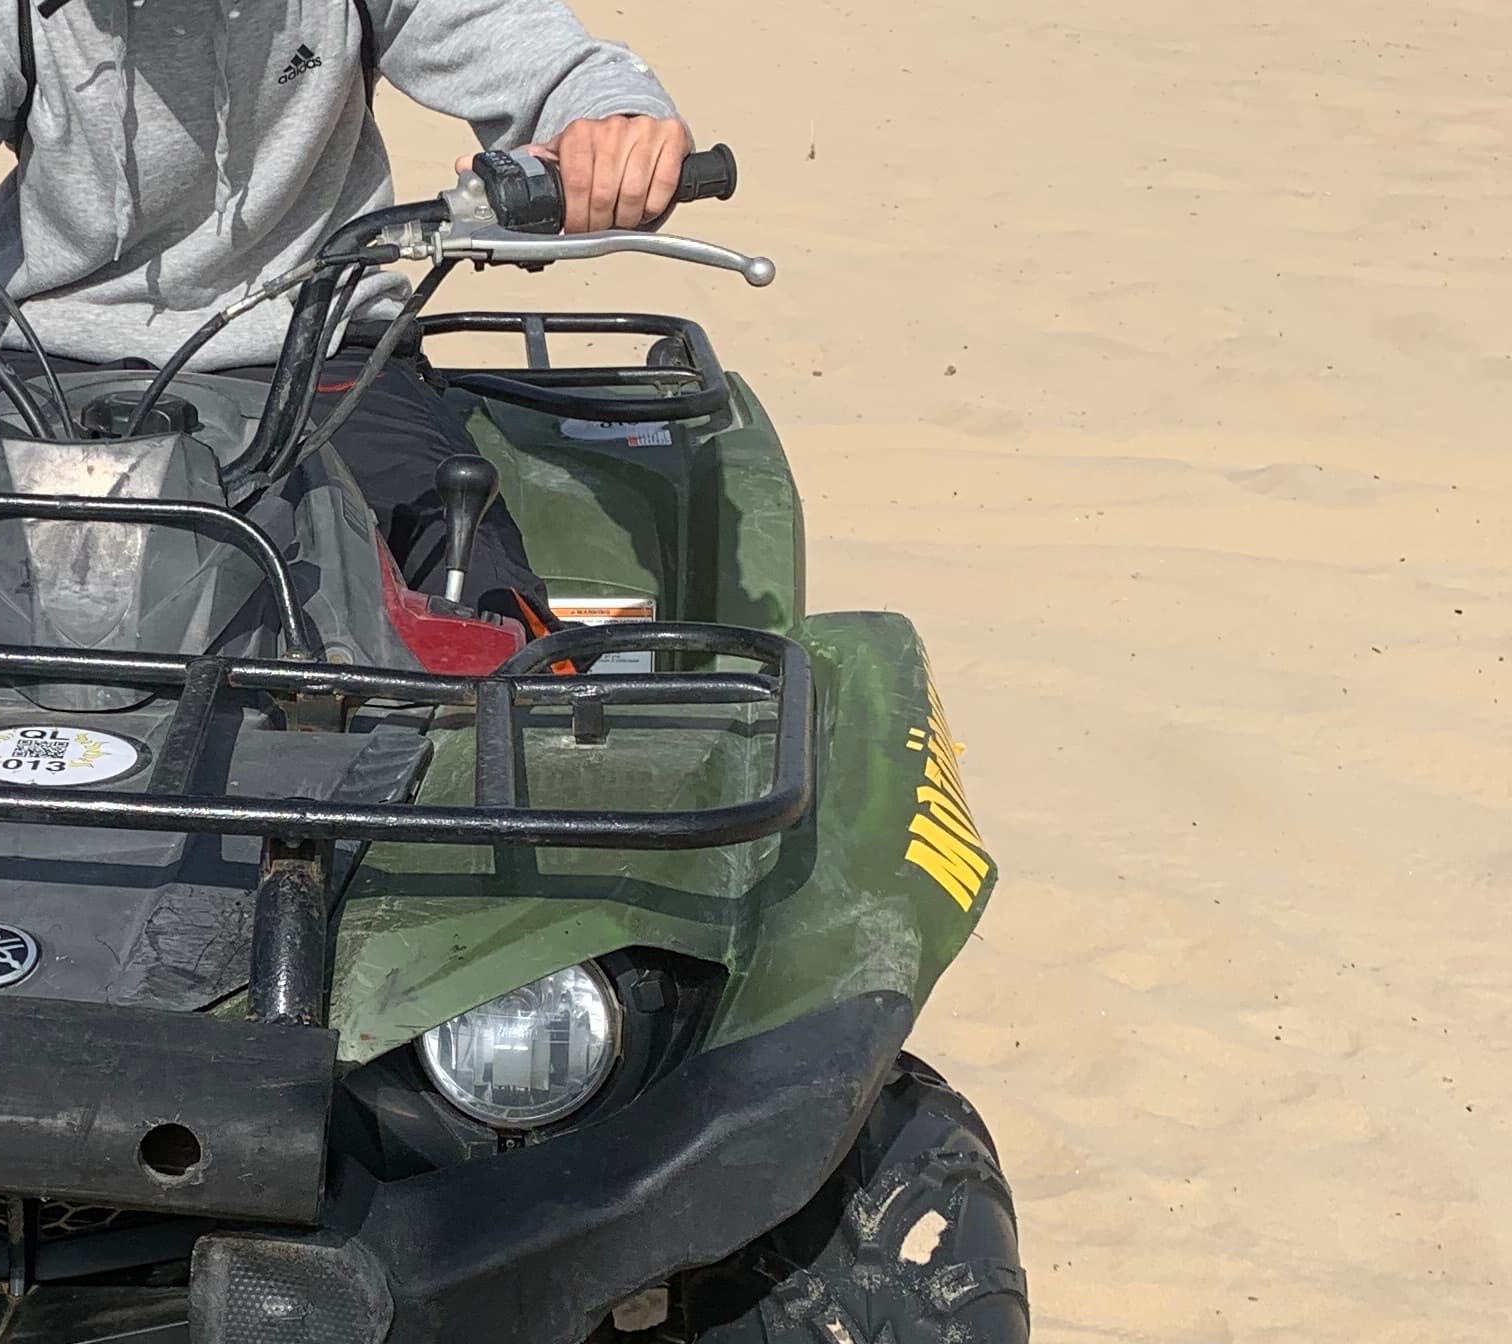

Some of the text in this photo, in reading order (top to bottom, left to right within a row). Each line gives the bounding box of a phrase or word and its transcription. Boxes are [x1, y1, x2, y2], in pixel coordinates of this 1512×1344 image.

[277, 56, 322, 85] adidas
[19, 729, 70, 741] QL
[2, 758, 67, 772] 013
